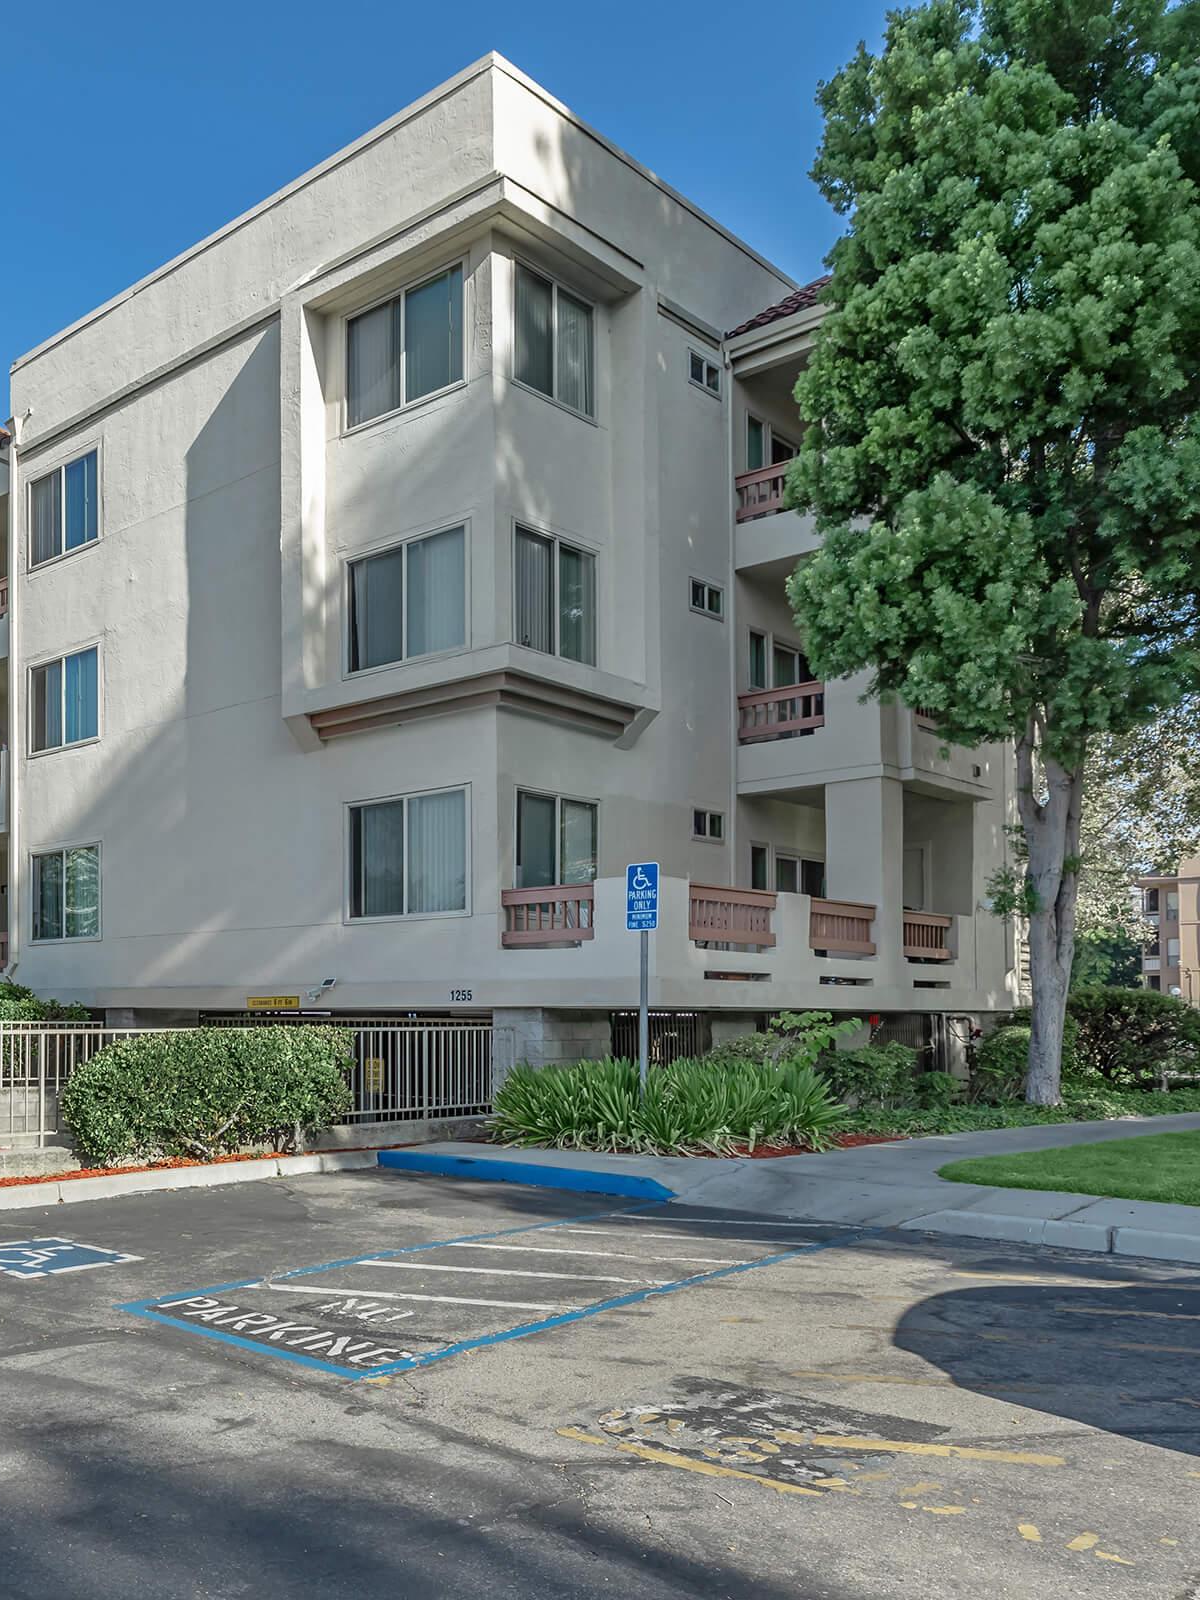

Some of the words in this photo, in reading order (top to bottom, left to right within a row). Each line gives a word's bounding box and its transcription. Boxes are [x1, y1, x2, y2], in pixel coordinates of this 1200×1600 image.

[629, 889, 656, 900] PARKING
[634, 900, 651, 910] ONLY
[450, 989, 472, 1001] 1255
[158, 1296, 414, 1367] PARKING
